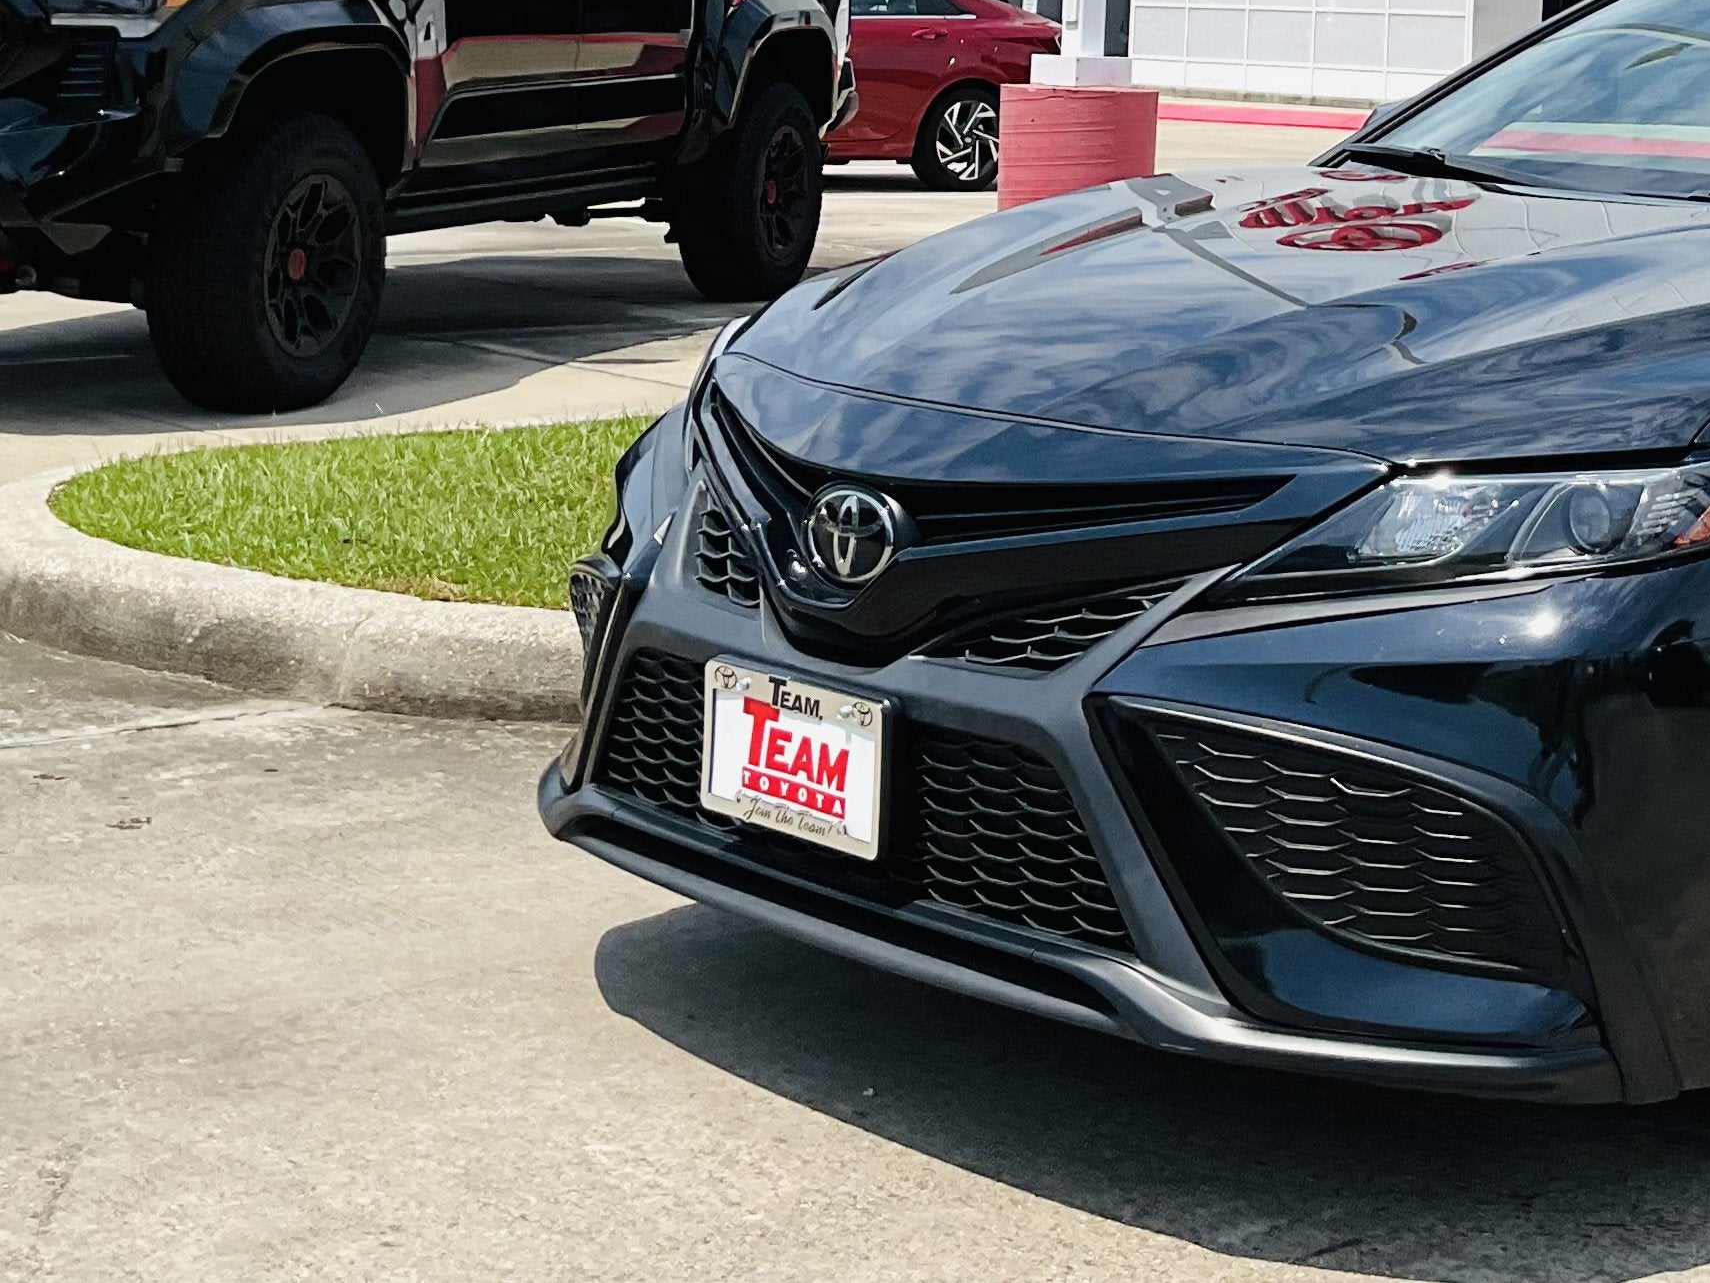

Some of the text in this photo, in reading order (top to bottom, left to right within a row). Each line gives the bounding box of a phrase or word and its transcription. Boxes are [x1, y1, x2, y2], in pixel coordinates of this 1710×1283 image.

[743, 696, 850, 792] TEAM
[743, 770, 843, 815] TOYOTA
[743, 794, 772, 821] Join
